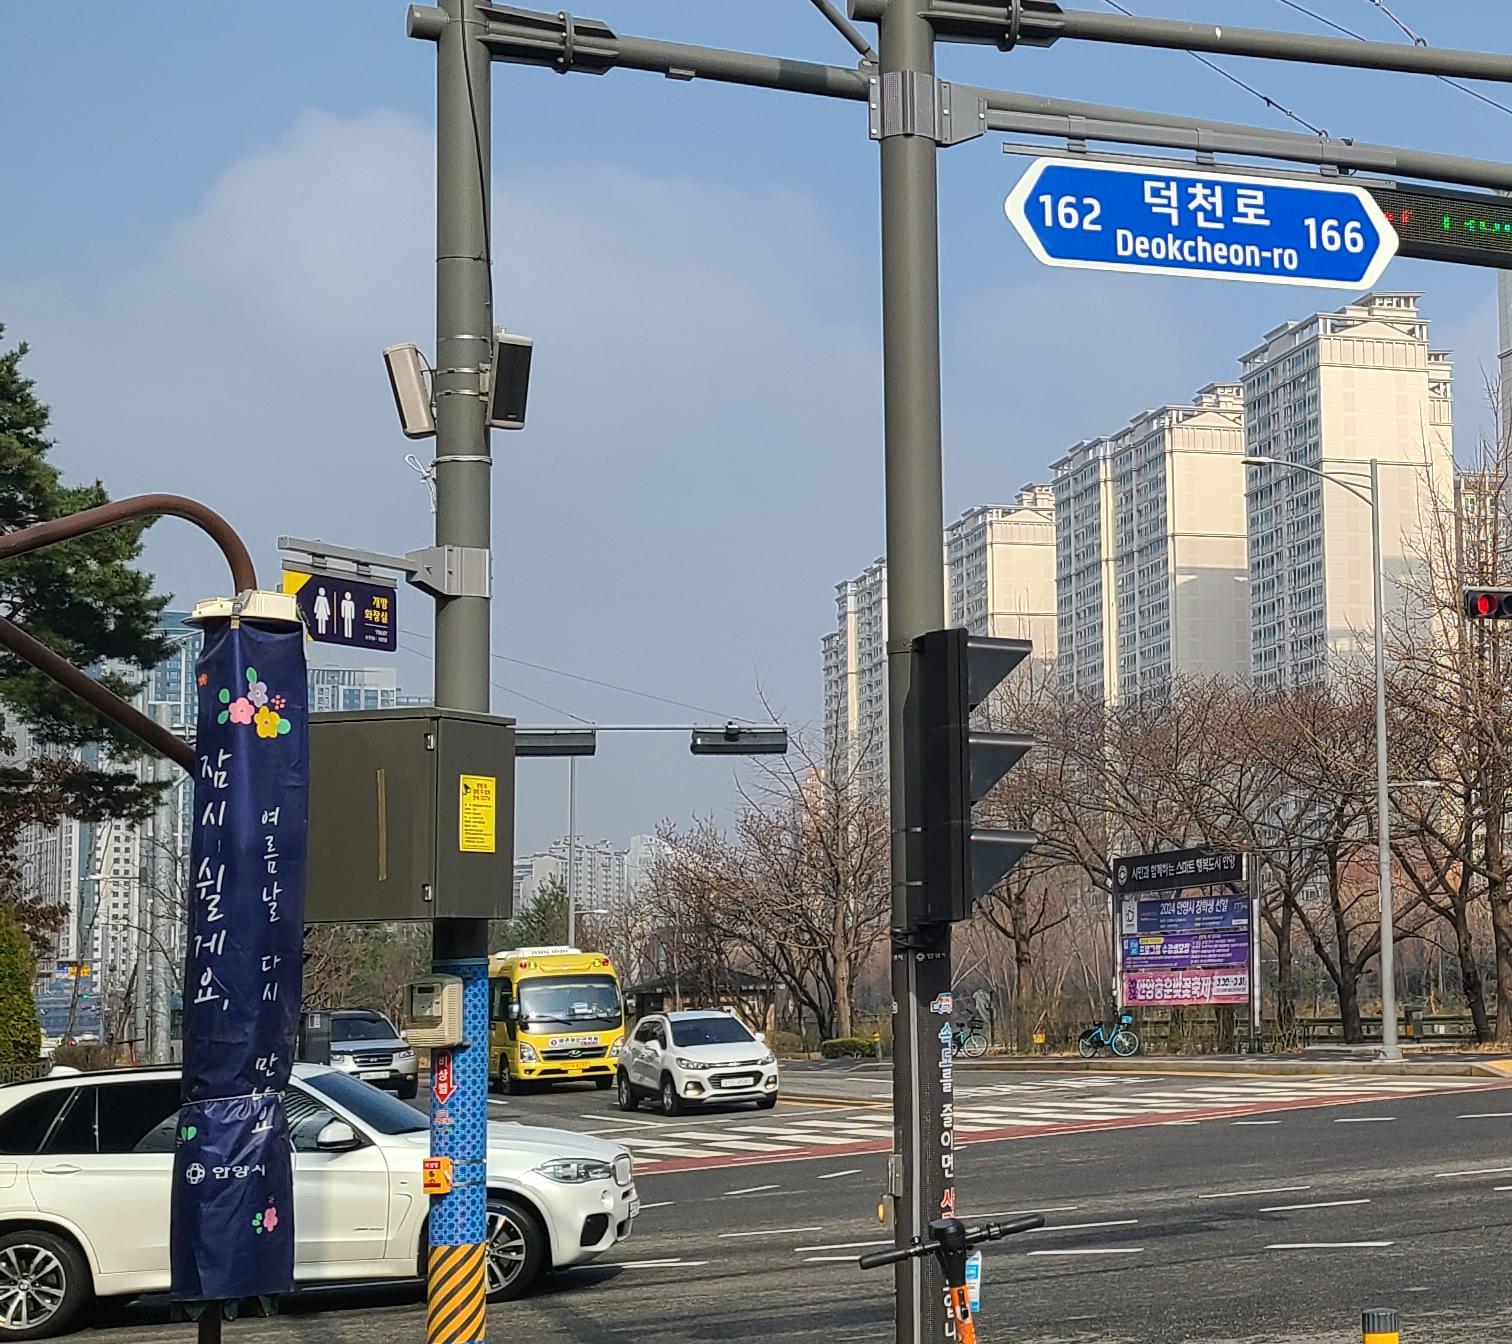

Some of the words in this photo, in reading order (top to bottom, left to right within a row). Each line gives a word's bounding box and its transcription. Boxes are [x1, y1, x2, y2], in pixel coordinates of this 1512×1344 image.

[1038, 193, 1103, 232] 162
[1143, 179, 1271, 229] 덕천로
[1115, 227, 1299, 272] Deokcheon-ro
[1303, 216, 1364, 254] 166
[364, 608, 389, 624] 화장실
[199, 748, 232, 828] 잠시
[261, 806, 283, 923] 여름날
[1160, 902, 1176, 915] 2024
[193, 856, 229, 1011] 쉴게요,
[261, 955, 282, 1002] 다시
[212, 1163, 266, 1179] 안양시
